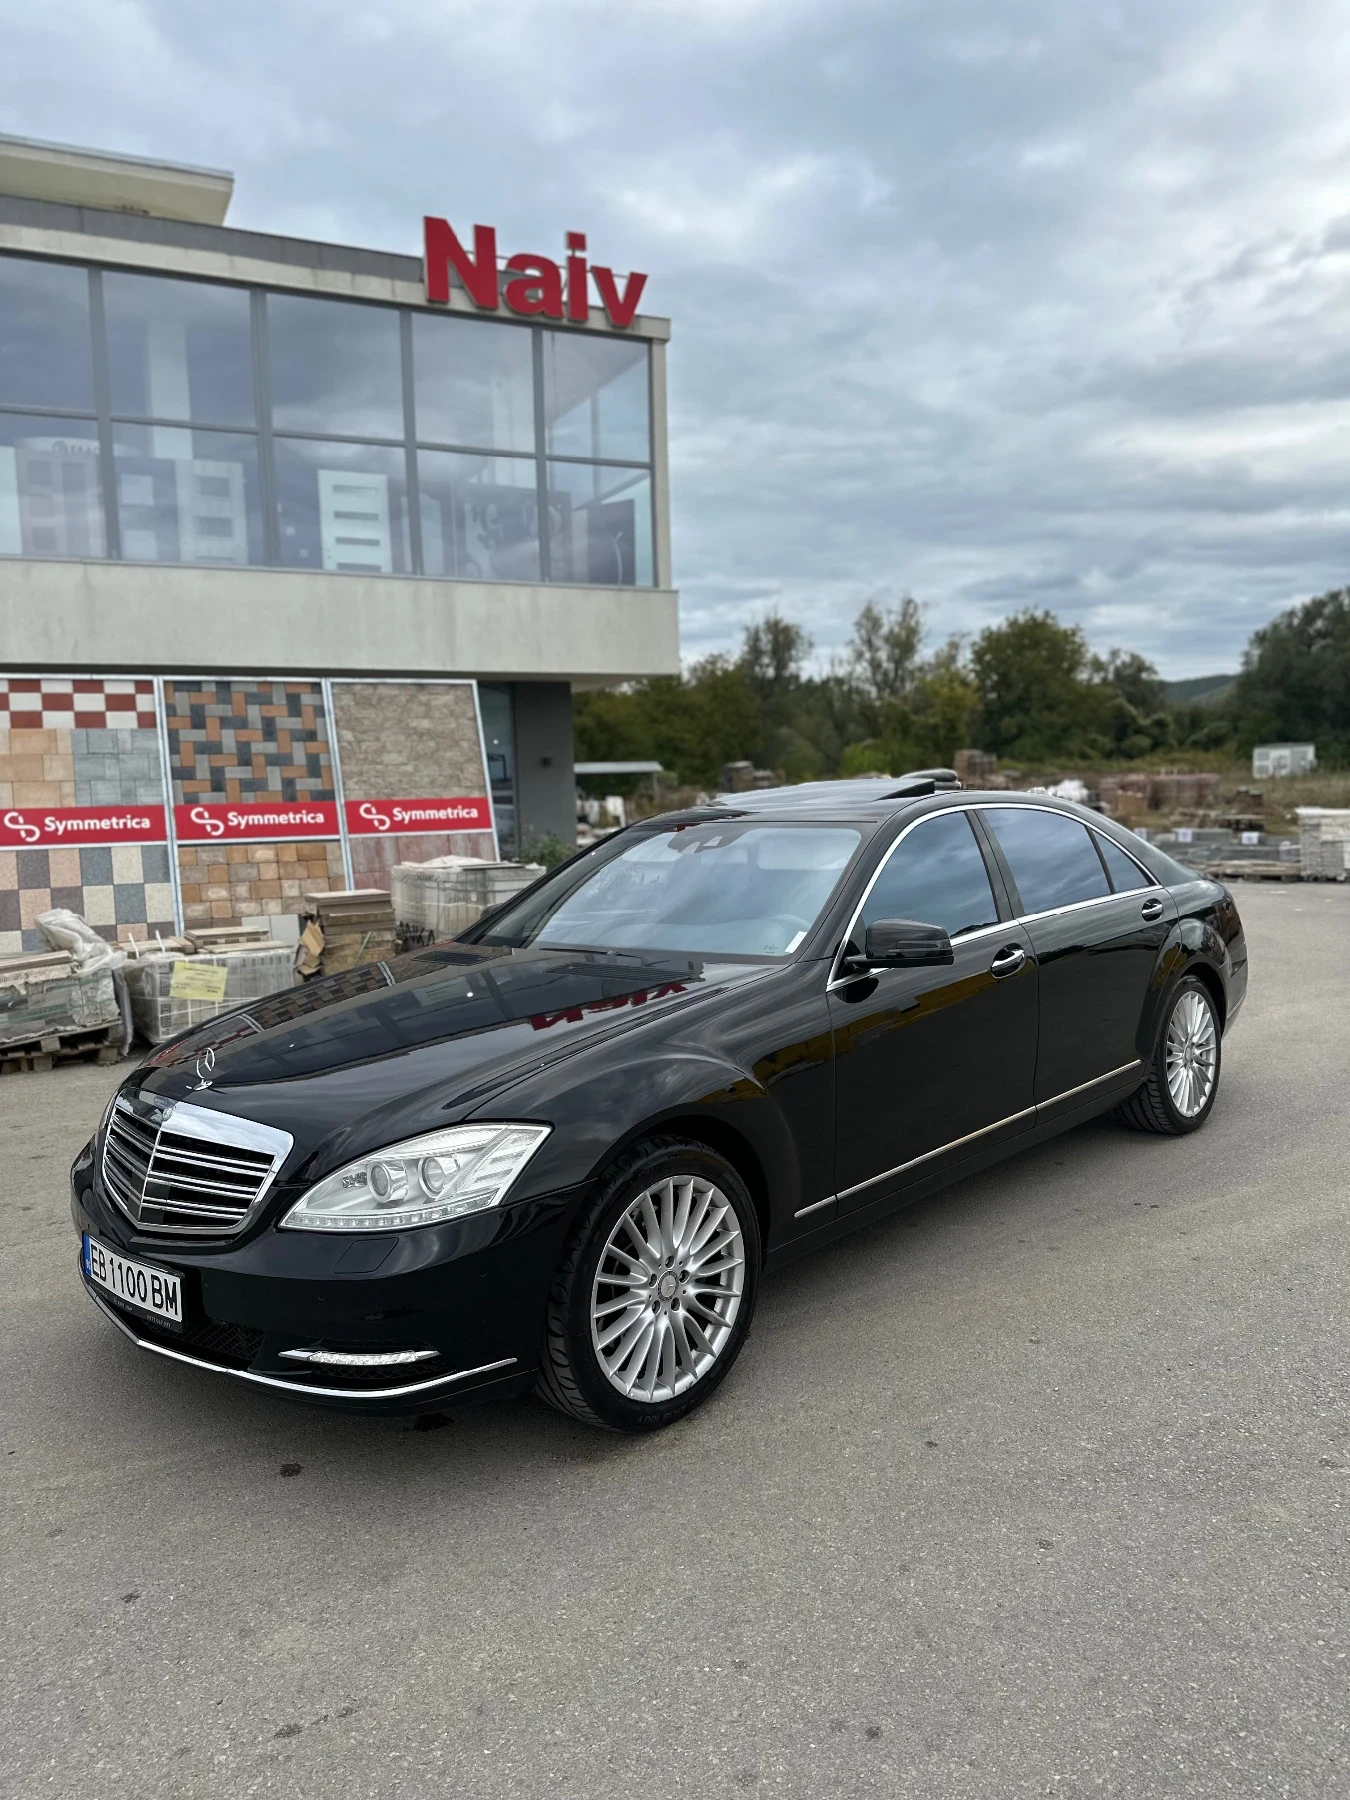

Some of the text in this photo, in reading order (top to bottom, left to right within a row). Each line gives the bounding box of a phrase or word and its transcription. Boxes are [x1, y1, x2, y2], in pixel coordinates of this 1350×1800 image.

[423, 215, 649, 328] Naiv
[43, 814, 151, 836] Symmetrica
[227, 809, 325, 831] Symmetrica
[391, 805, 479, 824] Symmetrica
[109, 1256, 148, 1303] 1100
[151, 1273, 178, 1316] BM
